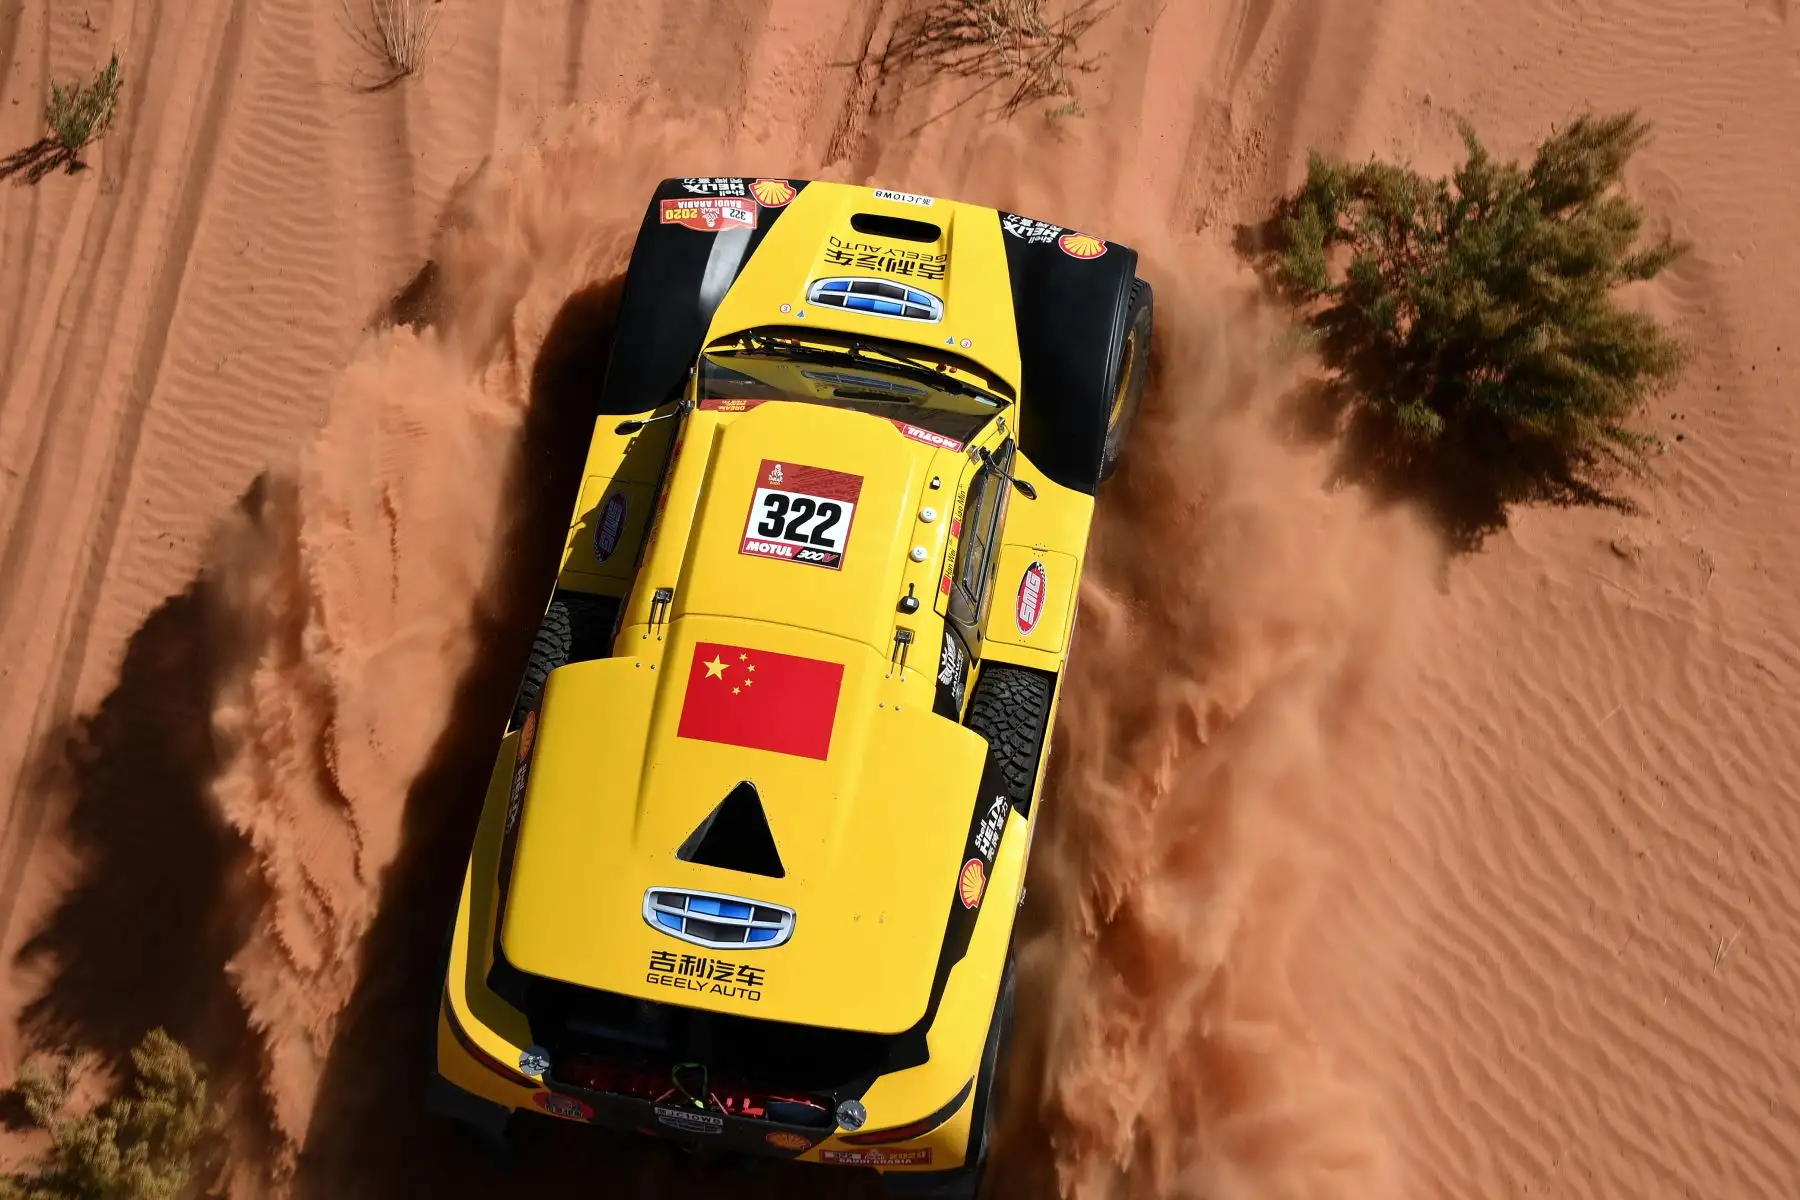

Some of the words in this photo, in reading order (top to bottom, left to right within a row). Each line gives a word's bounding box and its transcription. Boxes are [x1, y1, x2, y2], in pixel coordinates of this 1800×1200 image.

[682, 183, 745, 194] HELIX
[665, 208, 698, 219] 2020
[678, 201, 712, 209] ARABIA
[715, 200, 742, 208] SAUDI
[729, 208, 746, 220] 322
[1003, 219, 1059, 239] HELIX
[1028, 235, 1054, 244] Shell
[829, 235, 882, 253] AUTO
[824, 248, 946, 280] 吉利汽车
[888, 248, 947, 263] GEELY
[907, 426, 958, 448] MOTUL
[758, 493, 841, 548] 322
[746, 541, 793, 557] MOTUL
[796, 549, 839, 563] 300V
[1019, 569, 1042, 626] SMG
[974, 818, 988, 849] Shell
[980, 795, 1005, 856] HELIX
[649, 950, 766, 987] 吉利汽车
[646, 972, 709, 992] GEELY
[710, 984, 761, 1002] AUTO
